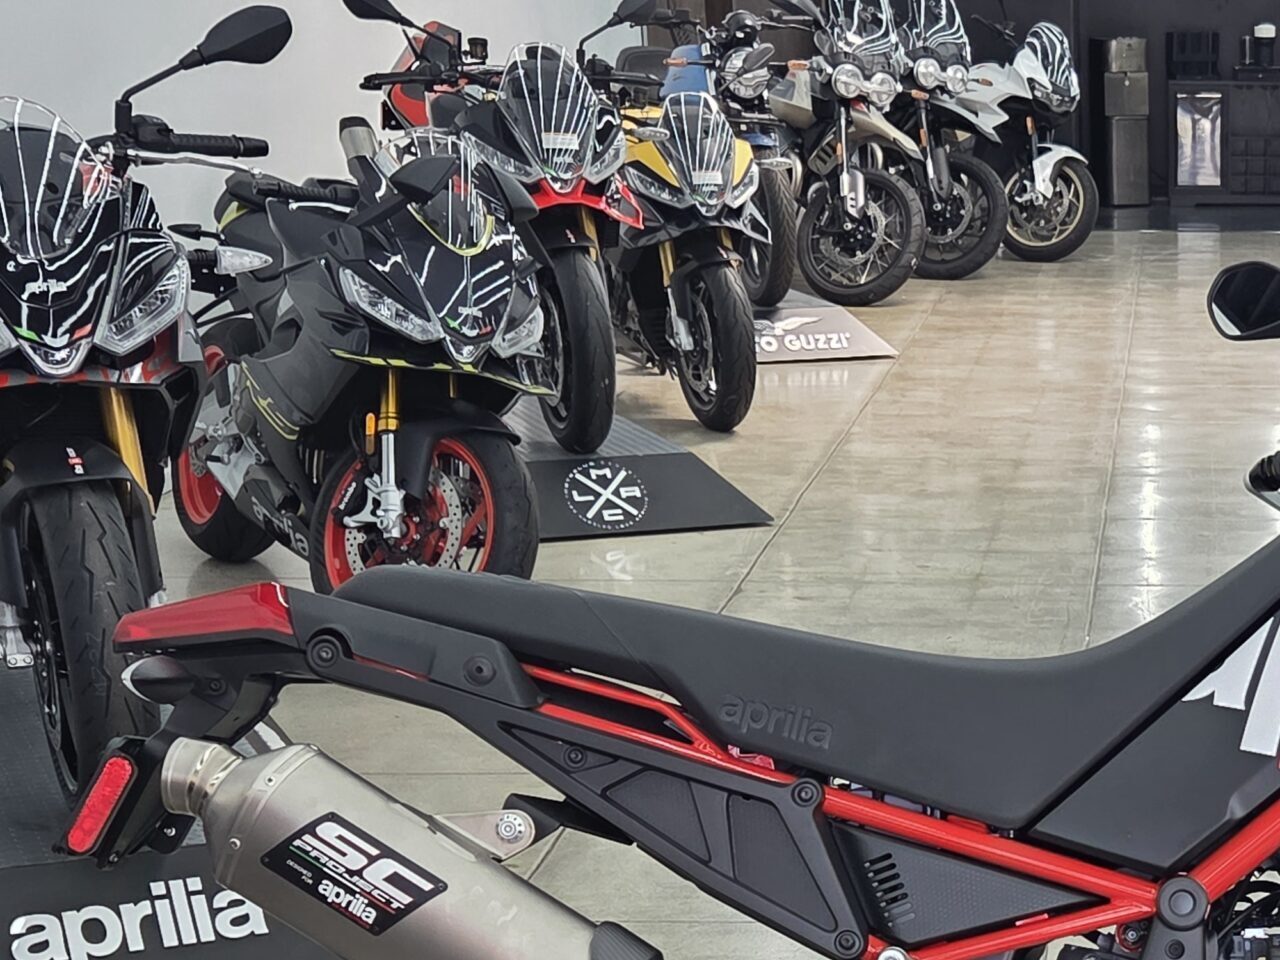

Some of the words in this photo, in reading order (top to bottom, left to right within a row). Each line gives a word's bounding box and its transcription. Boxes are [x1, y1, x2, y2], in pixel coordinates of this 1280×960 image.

[783, 332, 850, 352] GUZZI
[718, 694, 834, 750] aprilia
[290, 838, 406, 910] PROJECT
[300, 820, 436, 906] SC
[317, 878, 378, 925] aprilia
